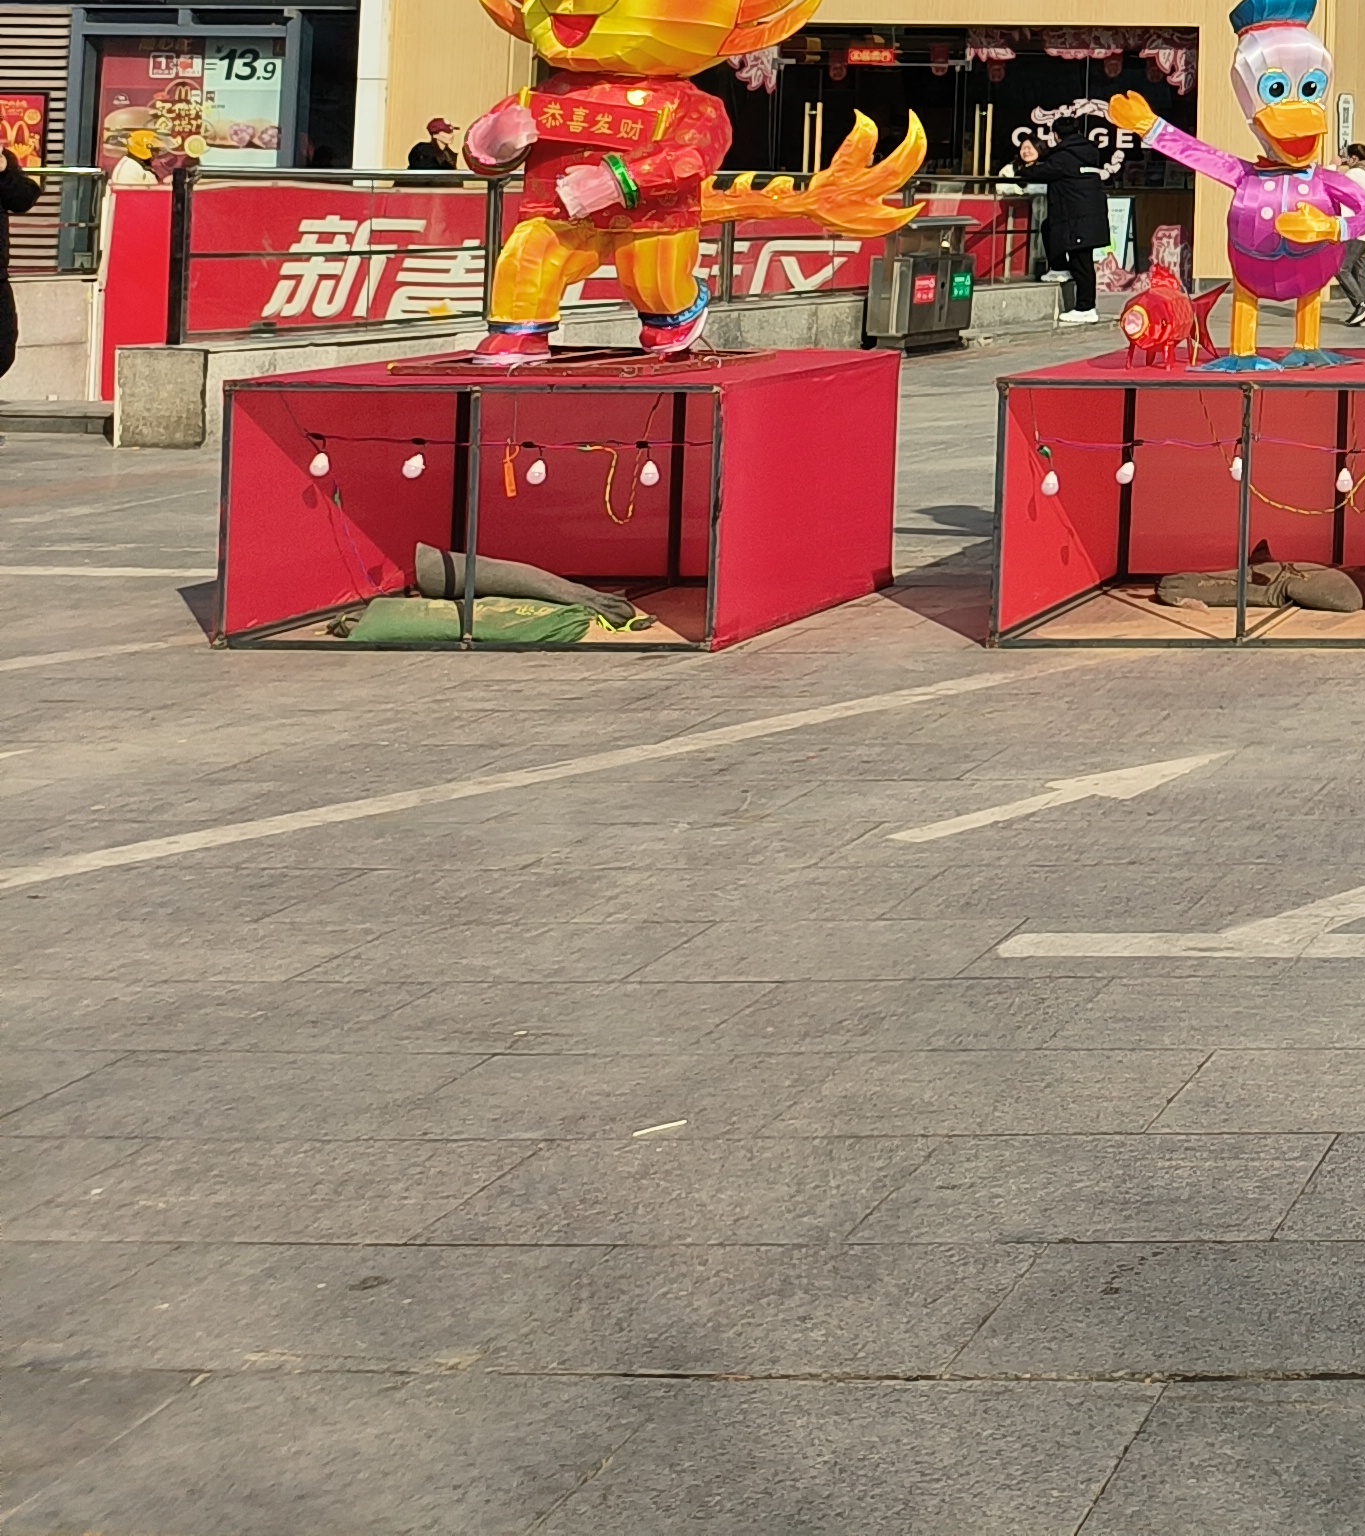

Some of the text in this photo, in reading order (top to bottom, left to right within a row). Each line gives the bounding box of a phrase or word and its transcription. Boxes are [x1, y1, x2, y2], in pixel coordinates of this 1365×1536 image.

[538, 101, 645, 141] 恭喜发财
[1011, 126, 1152, 149] CHGE
